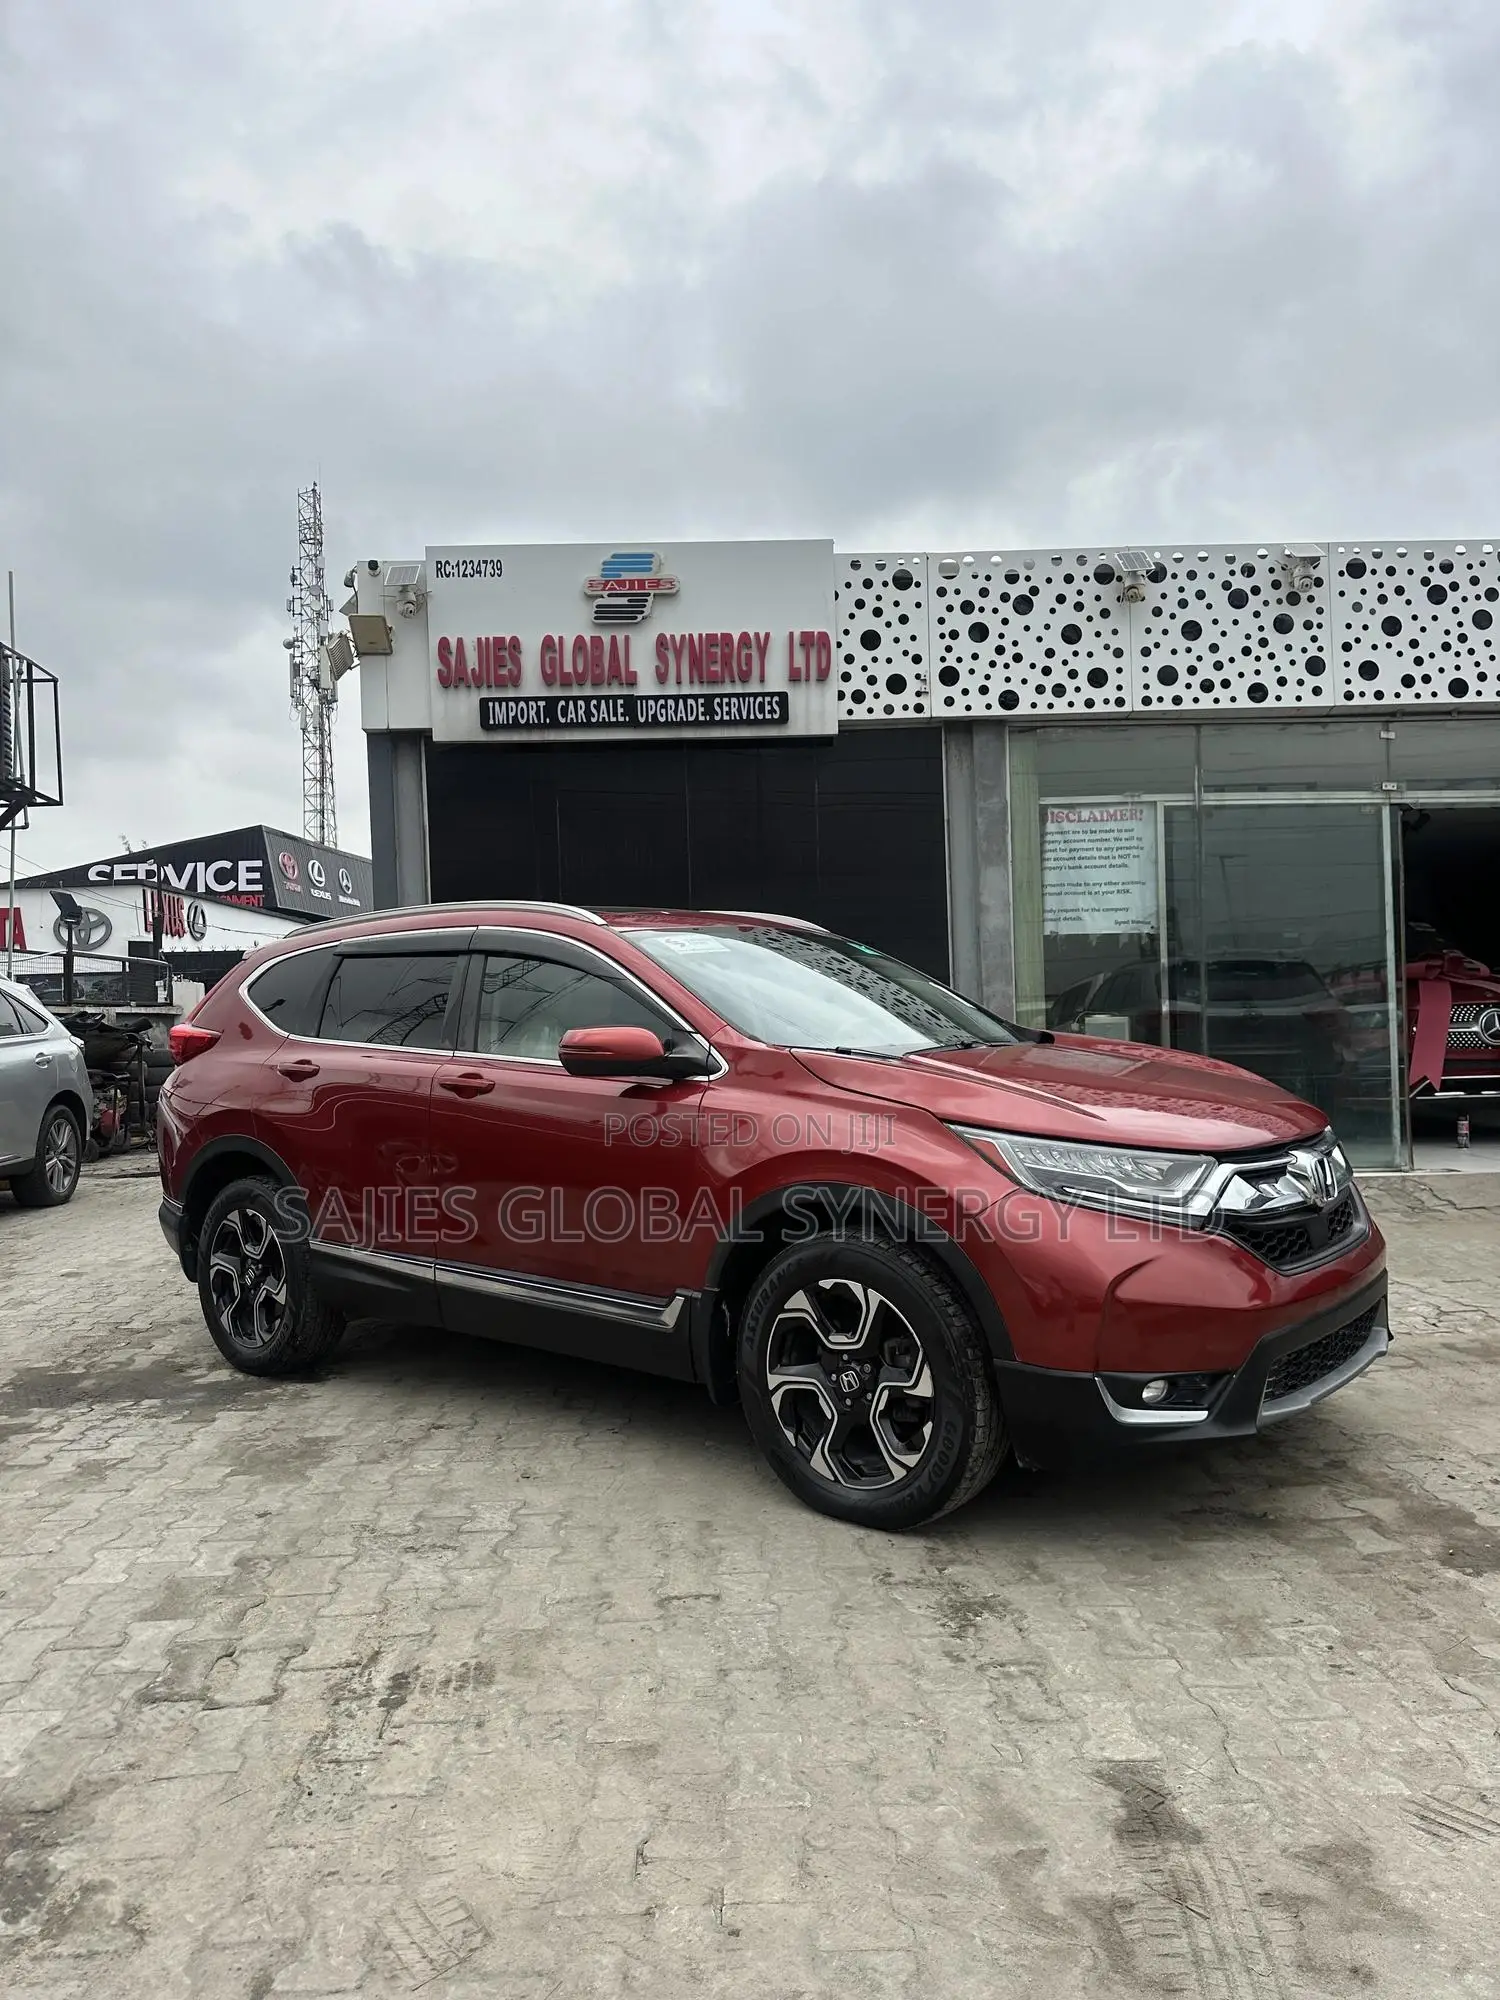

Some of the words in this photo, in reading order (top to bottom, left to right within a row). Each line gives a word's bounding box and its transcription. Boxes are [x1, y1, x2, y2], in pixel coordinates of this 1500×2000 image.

[435, 559, 503, 578] RC:1234739
[586, 580, 676, 591] SAJIES
[437, 635, 522, 688] SAJIES
[540, 634, 638, 686] GLOBAL
[655, 631, 771, 684] SYNERGY
[788, 630, 832, 682] LTD
[488, 700, 550, 725] IMPORT.
[557, 700, 586, 723] CAR
[590, 698, 630, 722] SALE.
[637, 698, 710, 722] UPGRADE.
[714, 696, 781, 721] SERVICES
